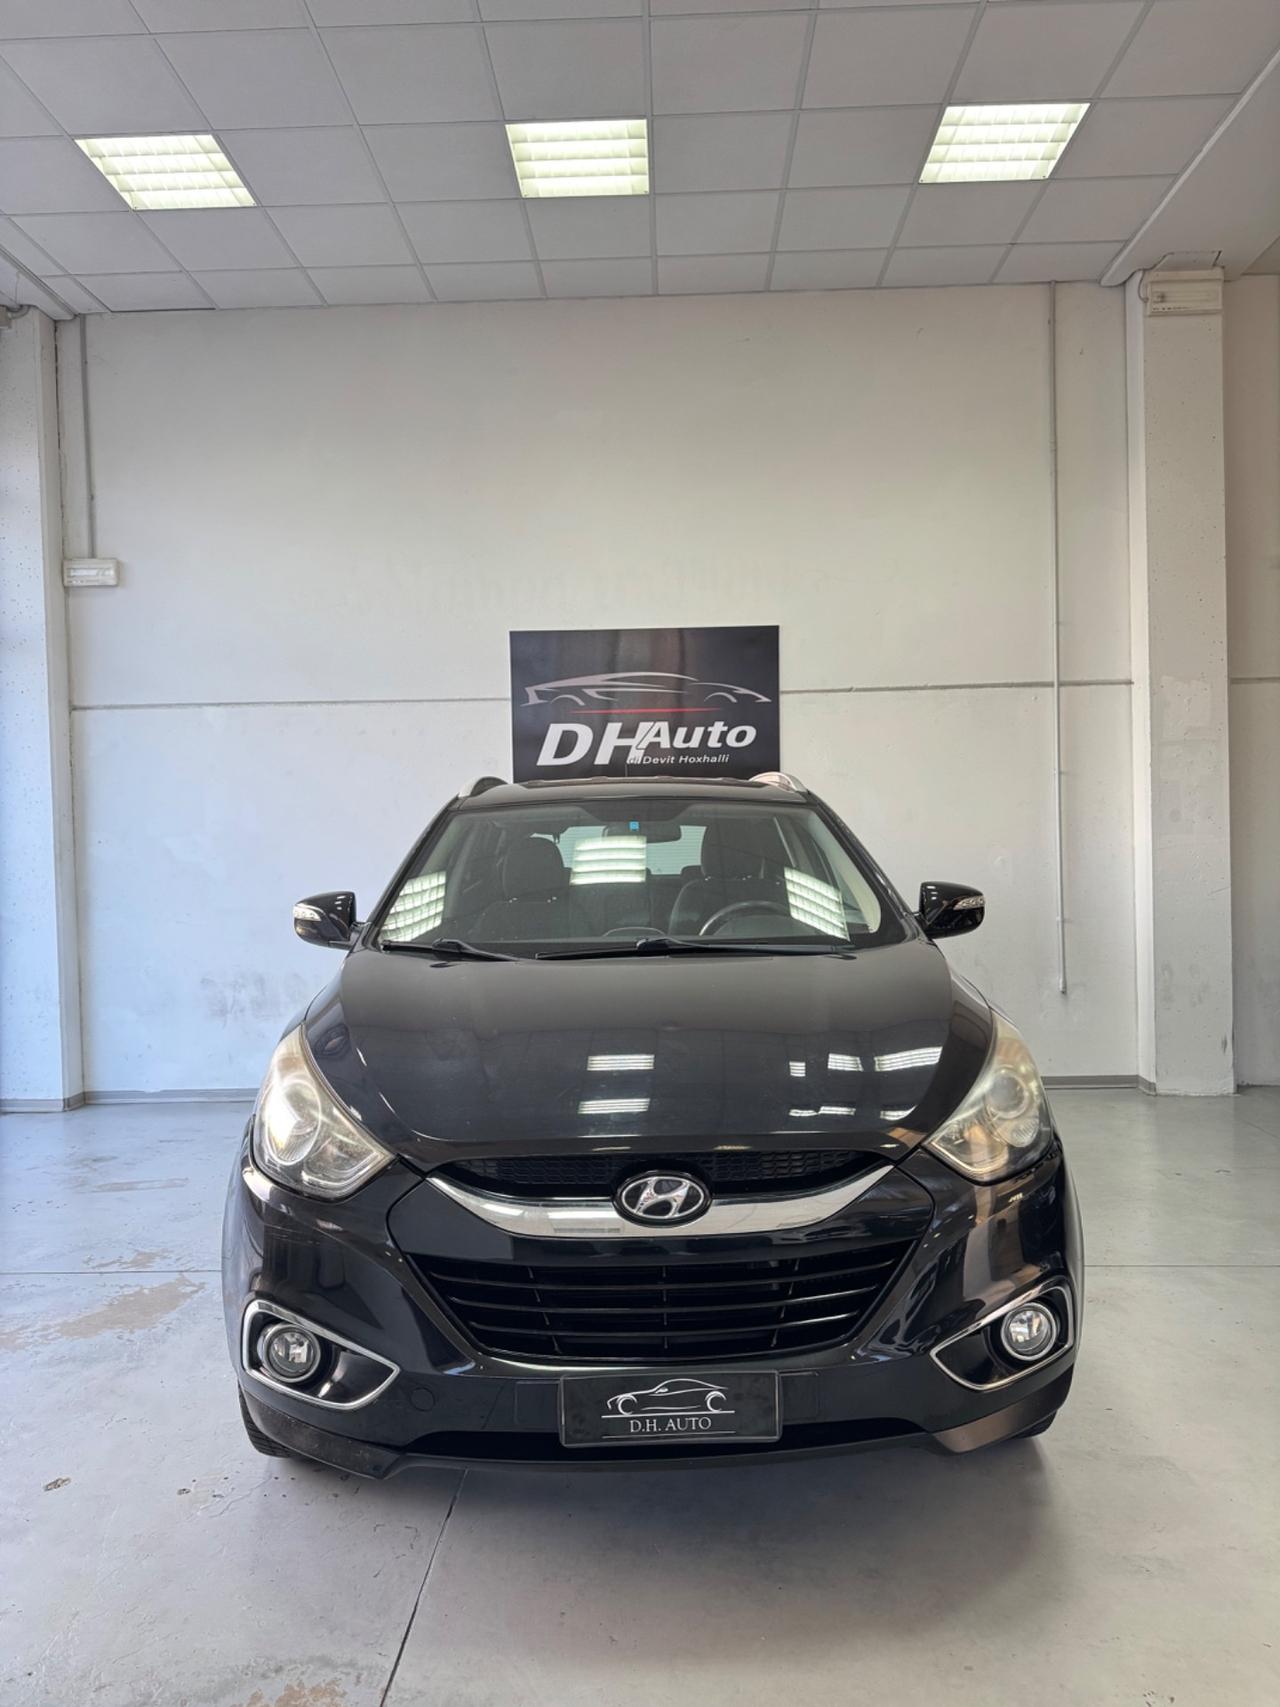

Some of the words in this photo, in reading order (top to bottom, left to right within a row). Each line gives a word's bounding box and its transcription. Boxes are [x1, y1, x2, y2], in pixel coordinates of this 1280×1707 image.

[636, 721, 757, 748] Auto
[642, 755, 675, 765] Devit
[678, 754, 730, 764] Hoxhalli
[629, 1419, 662, 1433] D.H.
[665, 1416, 712, 1431] AUTO
